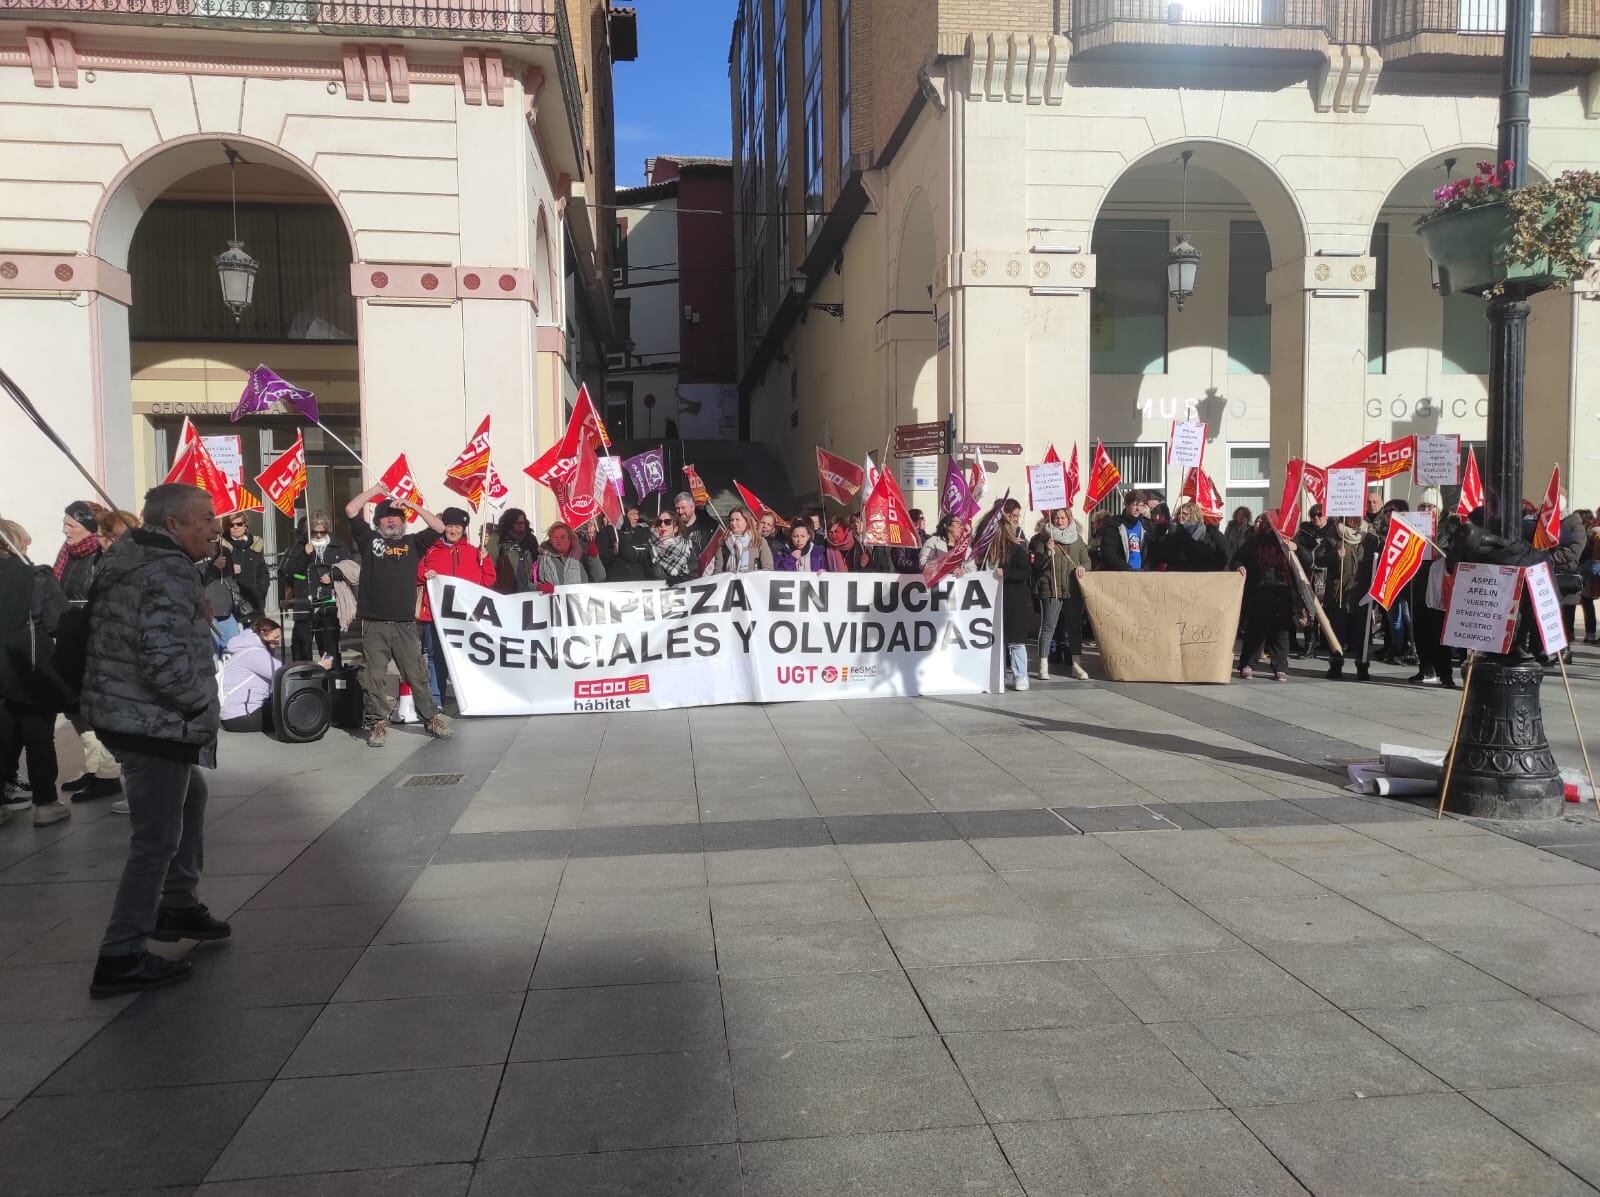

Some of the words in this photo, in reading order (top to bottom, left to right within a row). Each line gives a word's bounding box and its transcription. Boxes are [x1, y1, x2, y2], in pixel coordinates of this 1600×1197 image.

[151, 402, 209, 415] OFICINA
[1133, 397, 1248, 420] MUSO
[1471, 576, 1499, 586] ASPEL
[1467, 586, 1498, 597] AFELIN
[440, 583, 503, 629] LA
[521, 578, 753, 632] LIMPIEZA
[768, 578, 829, 614] EN
[846, 579, 993, 614] LUCHA
[1455, 608, 1492, 619] BENEFICIO
[1492, 612, 1503, 621] ES
[1460, 620, 1493, 631] NUESTRO
[442, 621, 722, 671] ESENCIALES
[731, 620, 758, 655] Y
[768, 617, 995, 655] OLVIDADAS
[776, 665, 819, 685] UGT
[850, 665, 878, 674] FeSMC
[577, 681, 626, 696] CCOO
[573, 696, 631, 711] hábitat
